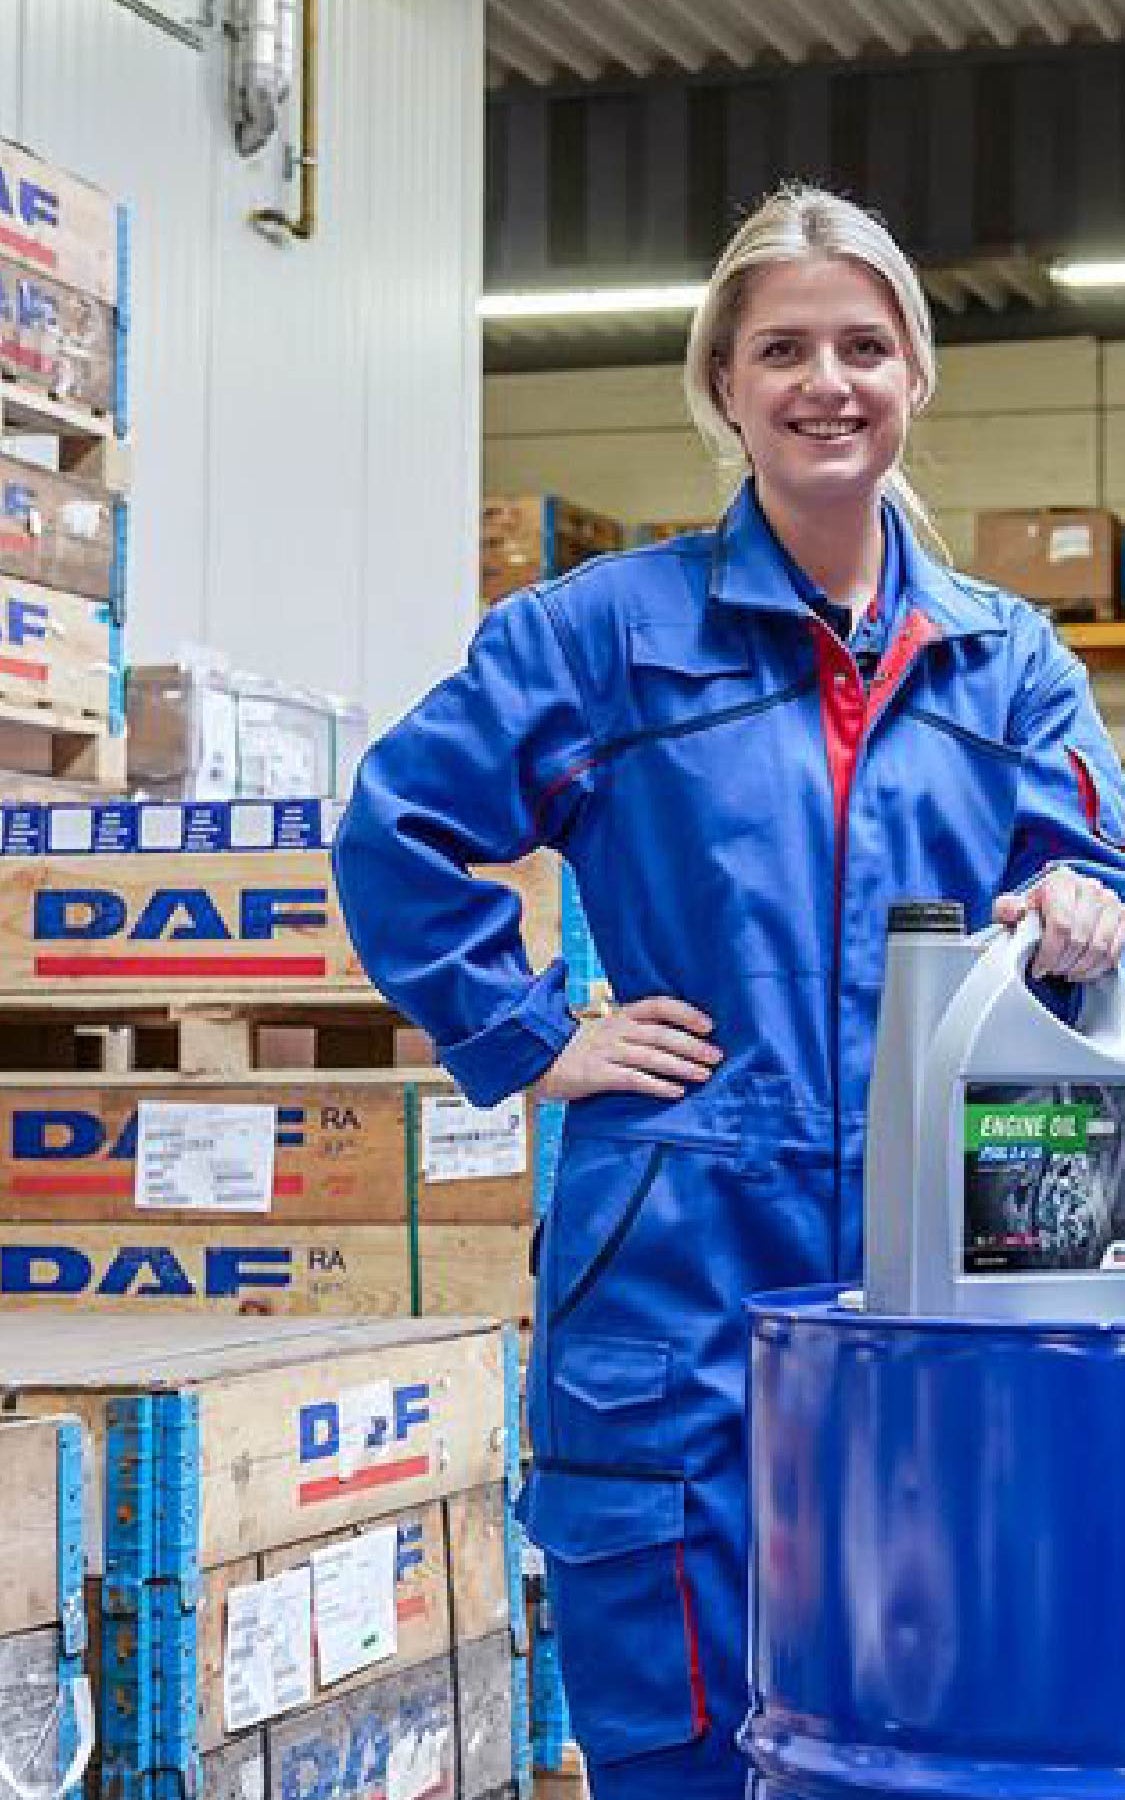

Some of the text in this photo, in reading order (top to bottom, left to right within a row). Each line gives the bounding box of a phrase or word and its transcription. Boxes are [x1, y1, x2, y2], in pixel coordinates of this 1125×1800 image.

[34, 888, 327, 939] DAF
[321, 1107, 361, 1130] RA
[981, 1114, 1046, 1137] ENGINE
[1050, 1114, 1077, 1137] OIL
[0, 1246, 292, 1298] DAF
[309, 1247, 347, 1270] RA
[299, 1384, 430, 1463] DF
